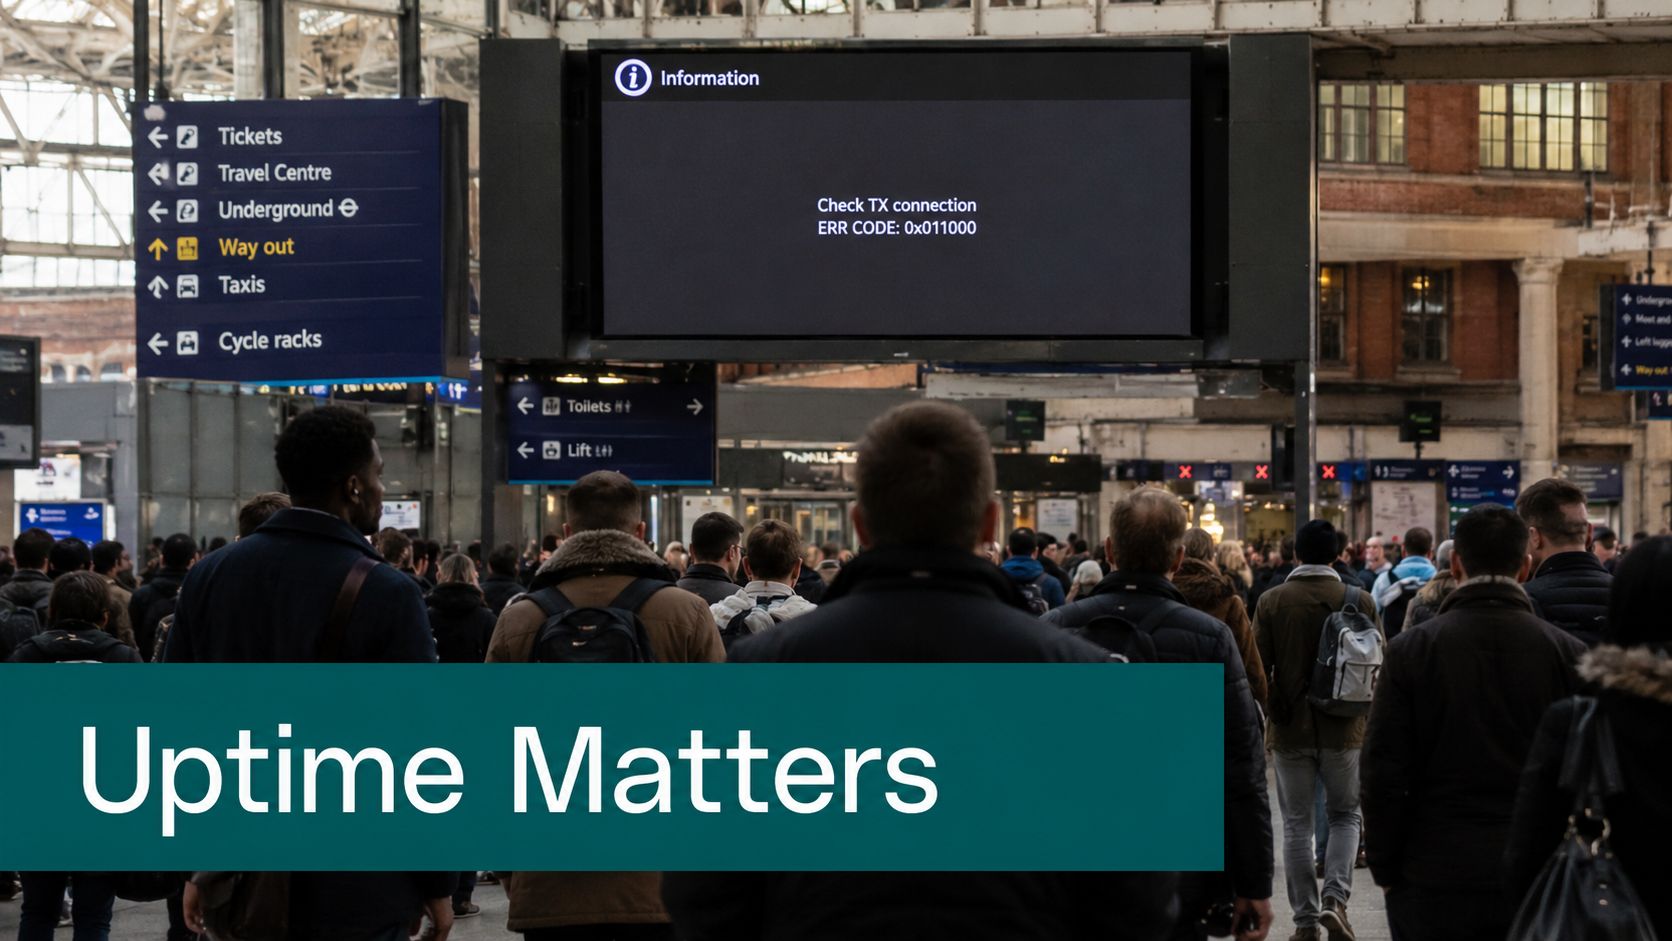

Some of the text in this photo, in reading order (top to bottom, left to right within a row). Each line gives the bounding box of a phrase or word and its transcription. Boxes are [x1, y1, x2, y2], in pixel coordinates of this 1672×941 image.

[661, 69, 760, 86] Information
[217, 126, 283, 146] Tickets
[217, 162, 332, 182] Travel Centre
[218, 198, 334, 223] Underground
[817, 197, 977, 213] Check TX connection
[818, 220, 977, 235] ERR CODE: 0x011000
[218, 238, 295, 261] Way out
[218, 274, 266, 294] Taxis
[218, 329, 323, 355] Cycle racks
[1636, 365, 1653, 376] Way
[567, 399, 612, 413] Toilets
[568, 442, 592, 458] Lift
